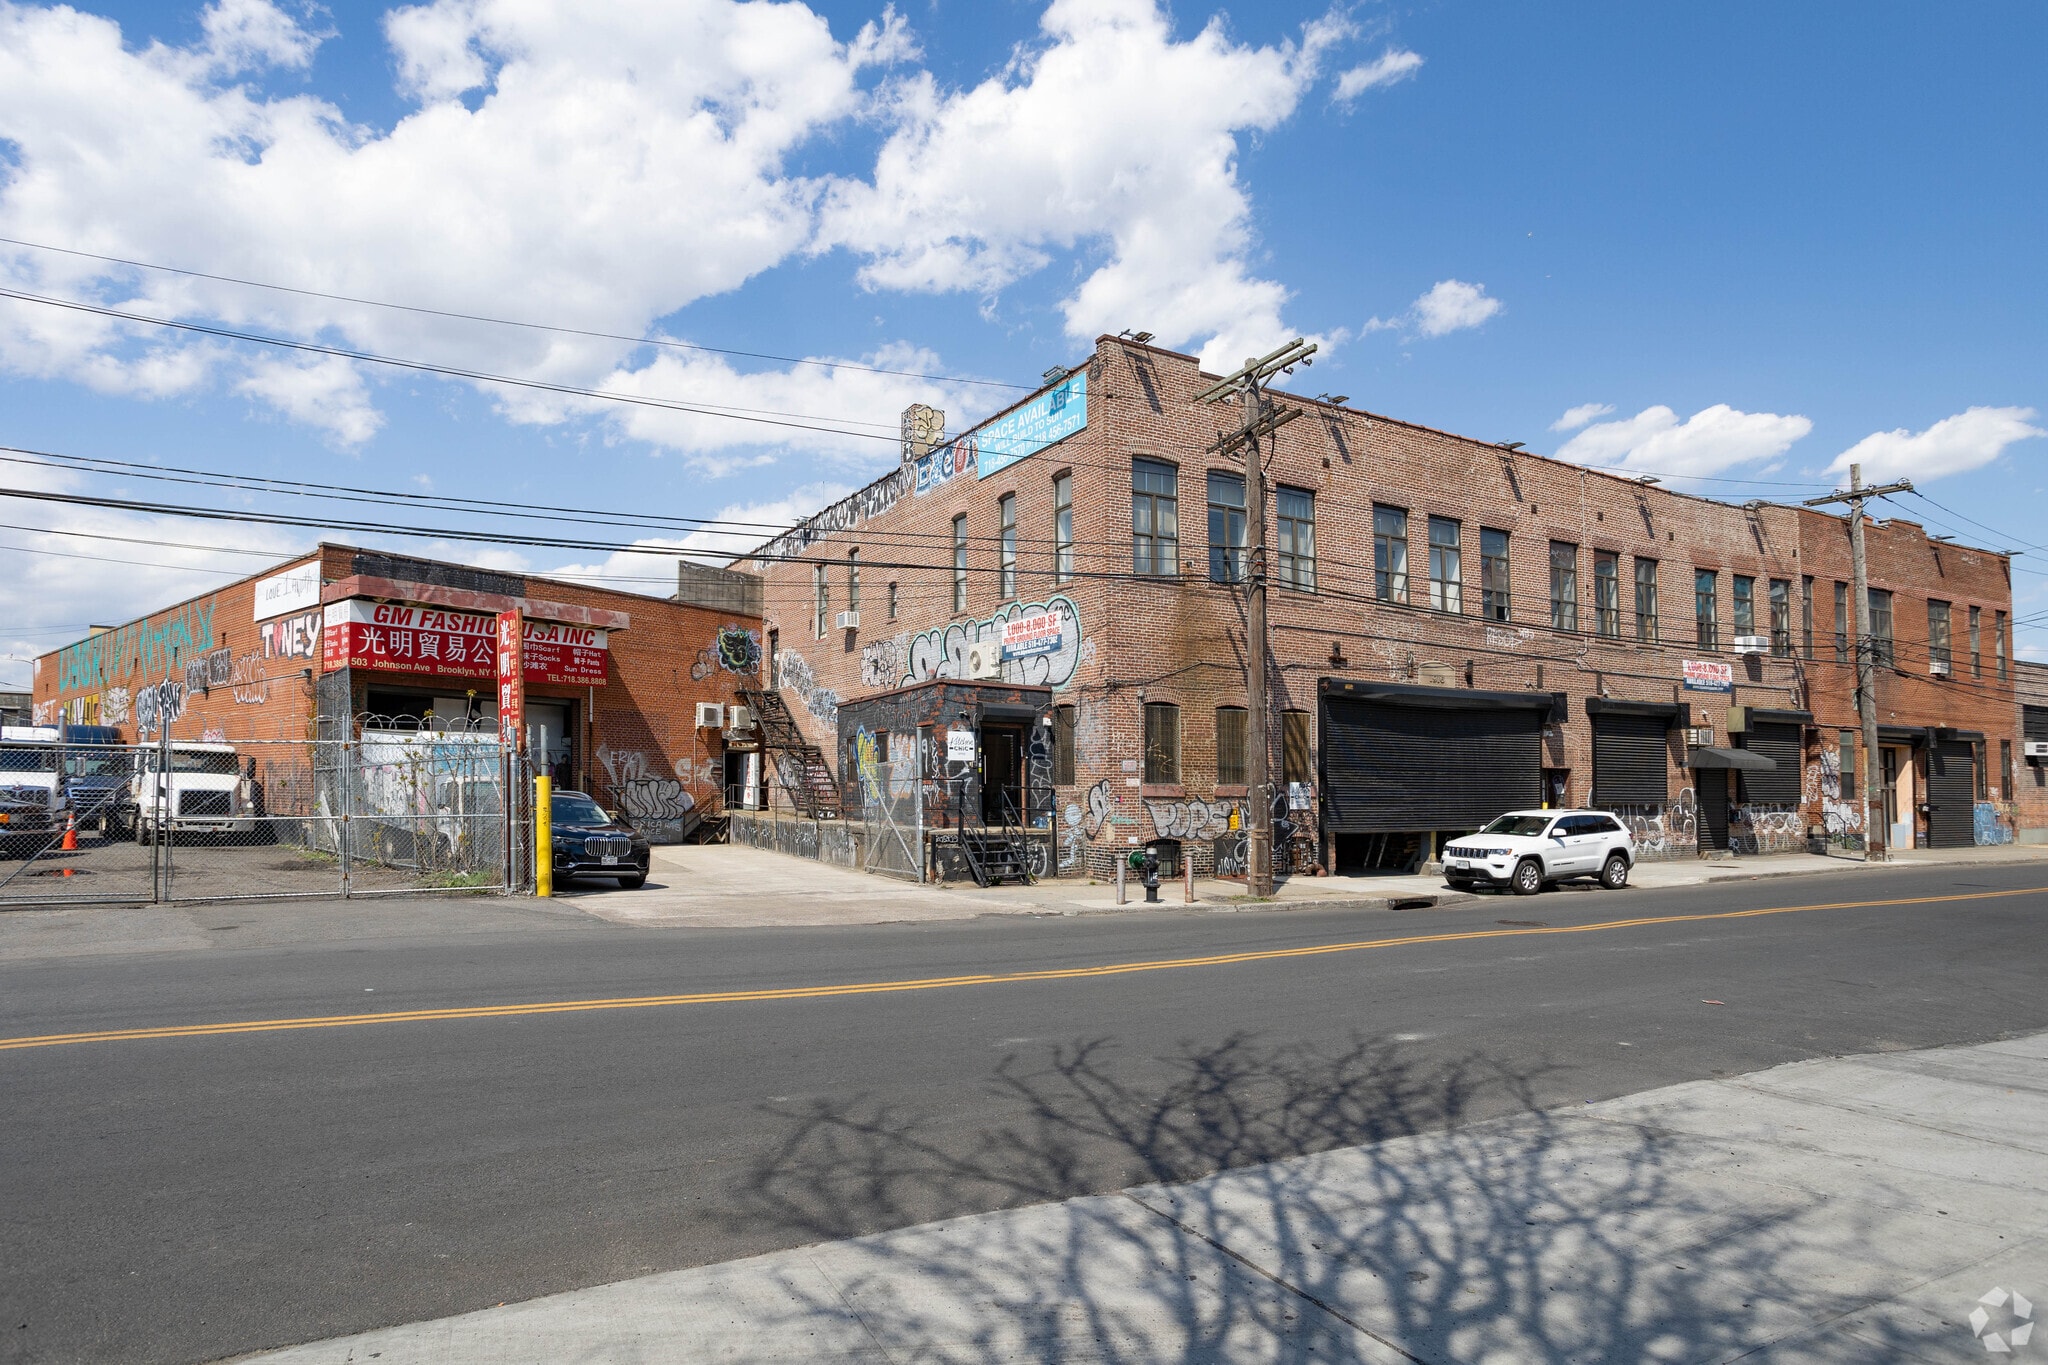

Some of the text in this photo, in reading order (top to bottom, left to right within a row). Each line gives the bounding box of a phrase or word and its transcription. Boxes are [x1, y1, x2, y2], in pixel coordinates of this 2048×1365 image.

[982, 382, 1081, 448] SPACE AVAILABLE
[995, 410, 1063, 453] WILL BUILD TO SUIT
[373, 604, 414, 625] GM
[418, 610, 498, 636] FASHIO
[523, 622, 559, 643] USA
[563, 627, 595, 646] INC
[1048, 613, 1057, 627] SF
[357, 626, 494, 665] 光明貿易公
[351, 658, 368, 667] 503
[372, 659, 412, 671] Johnson
[414, 662, 430, 672] Ave
[437, 664, 477, 677] Brooklyn,
[479, 667, 491, 677] NY
[564, 665, 602, 675] Sun Dress
